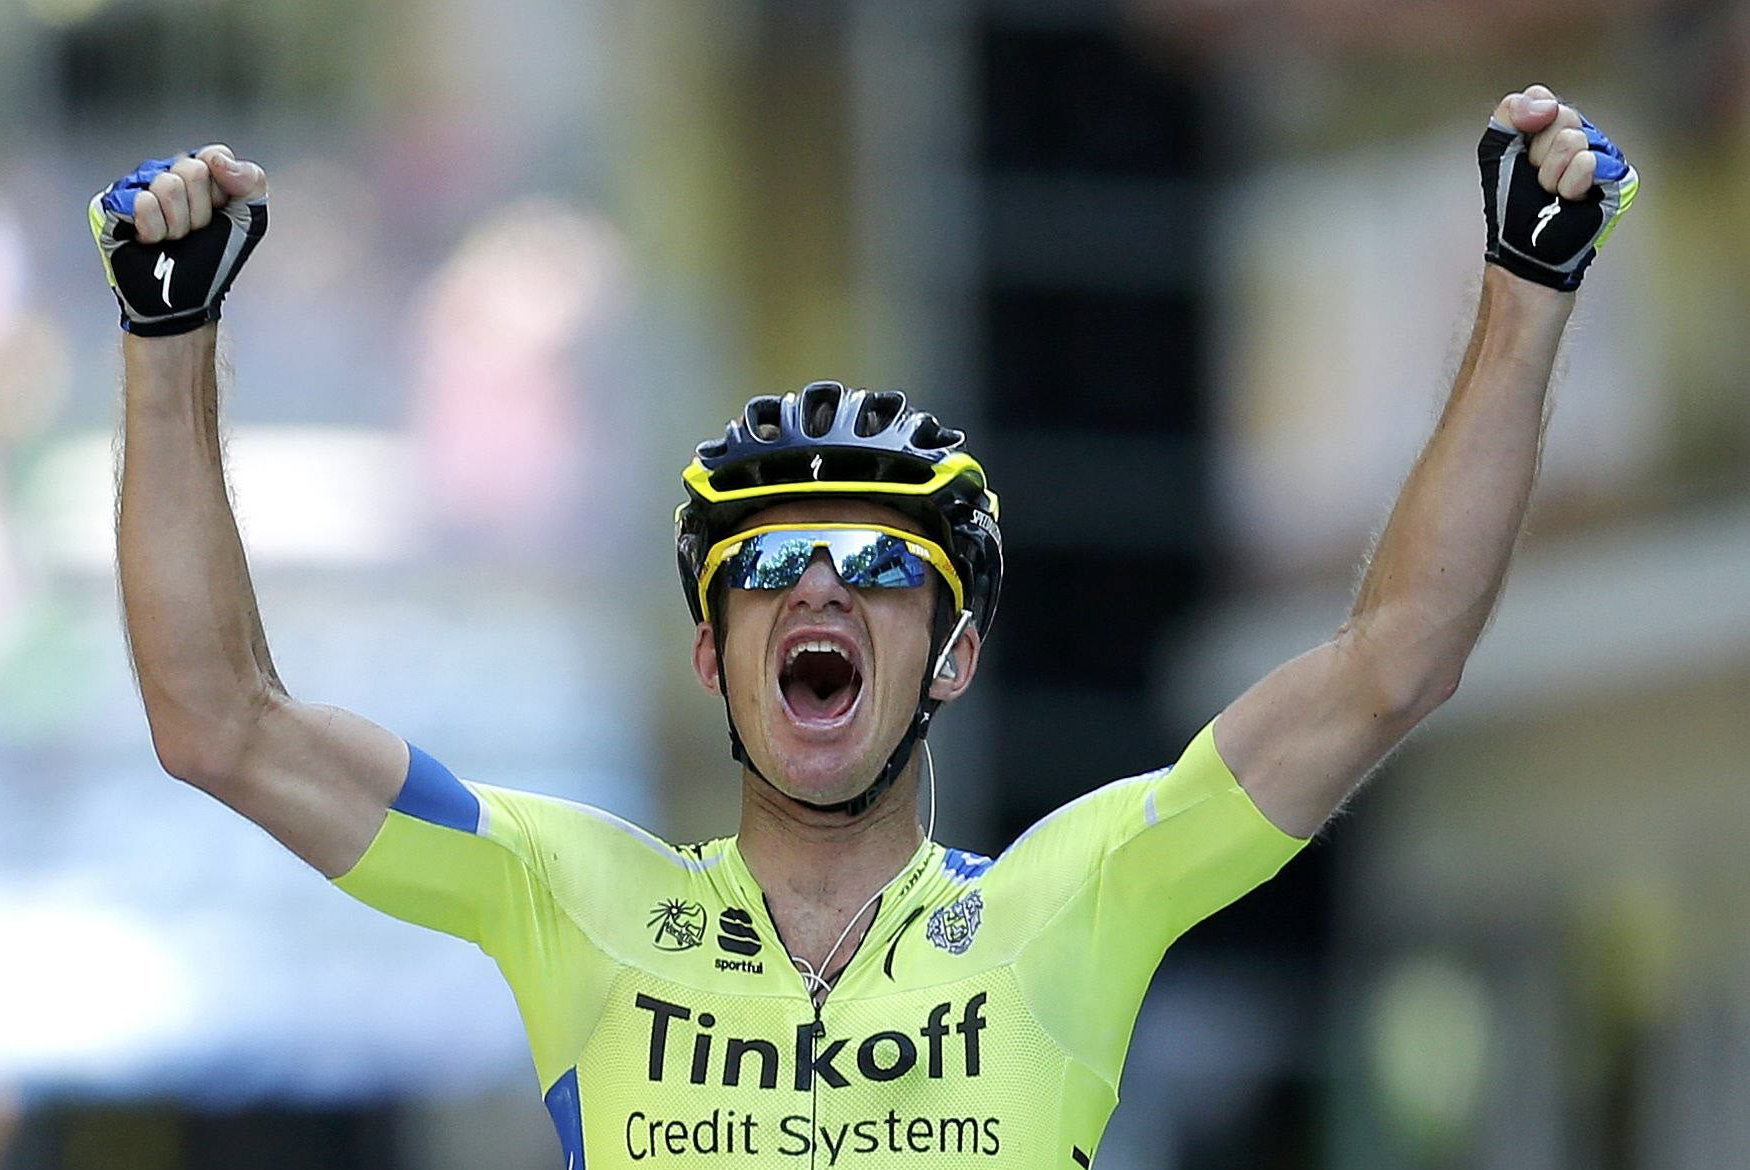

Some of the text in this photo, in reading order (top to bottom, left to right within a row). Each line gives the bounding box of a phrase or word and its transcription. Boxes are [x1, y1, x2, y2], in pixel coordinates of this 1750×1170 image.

[714, 958, 763, 974] sportful
[635, 992, 987, 1091] Tinkoff
[626, 1109, 1000, 1166] Credit Systems
